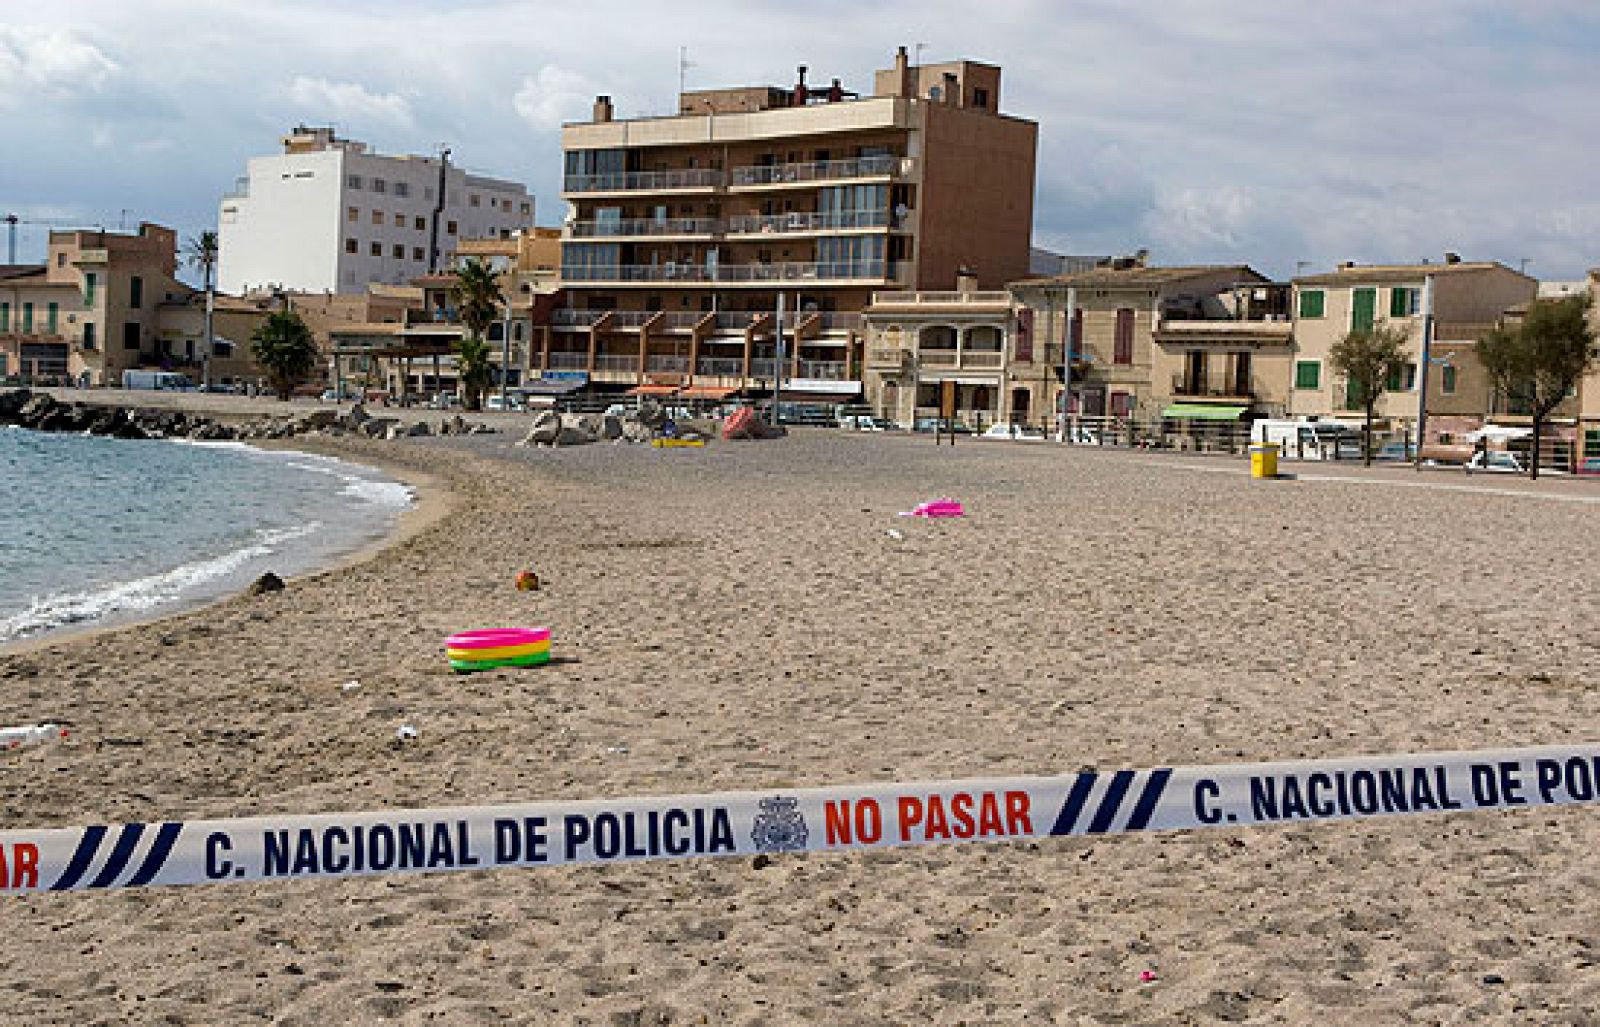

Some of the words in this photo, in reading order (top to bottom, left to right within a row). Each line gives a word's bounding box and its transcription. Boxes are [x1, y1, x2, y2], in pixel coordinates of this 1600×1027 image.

[824, 798, 882, 845] NO
[897, 790, 1032, 841] PASAR
[1194, 779, 1238, 825] C.
[1250, 764, 1462, 823] NACIONAL
[1469, 761, 1528, 807] DE
[205, 831, 246, 880] C.
[261, 820, 479, 877] NACIONAL
[494, 816, 548, 865] DE
[563, 807, 736, 860] POLICIA
